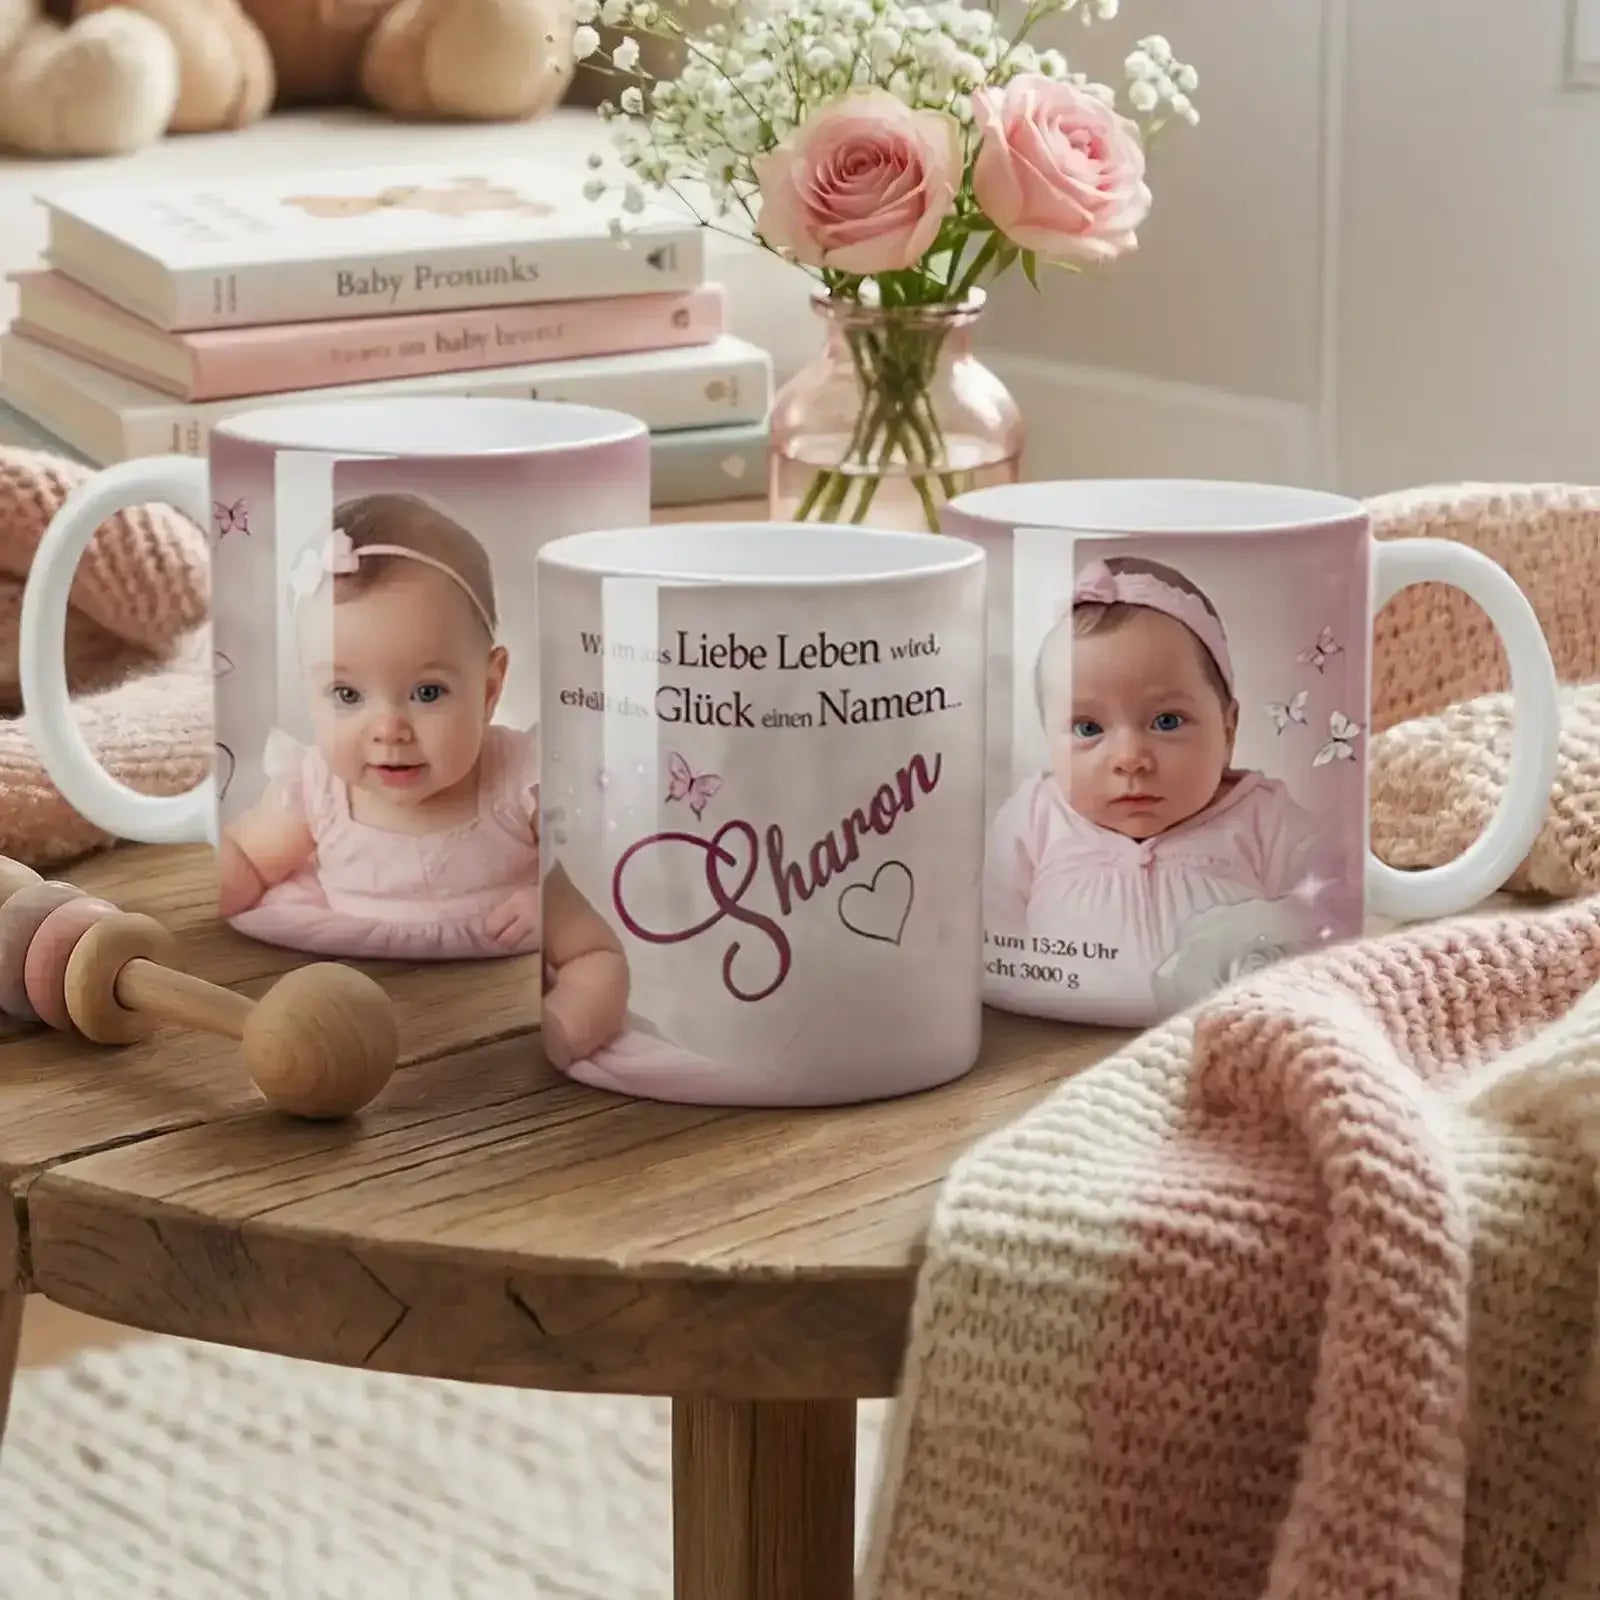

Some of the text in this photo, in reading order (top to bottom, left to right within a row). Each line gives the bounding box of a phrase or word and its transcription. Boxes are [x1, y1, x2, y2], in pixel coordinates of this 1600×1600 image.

[336, 266, 402, 305] Baby
[677, 631, 767, 670] Liebe
[777, 632, 881, 670] Leben
[890, 634, 941, 660] wird,
[655, 686, 755, 728] Glück
[761, 709, 813, 728] einen
[612, 751, 942, 1002] Sharon
[993, 933, 1025, 950] um
[1083, 941, 1119, 960] Uhr
[1020, 962, 1063, 982] 3000
[1067, 971, 1080, 990] g
